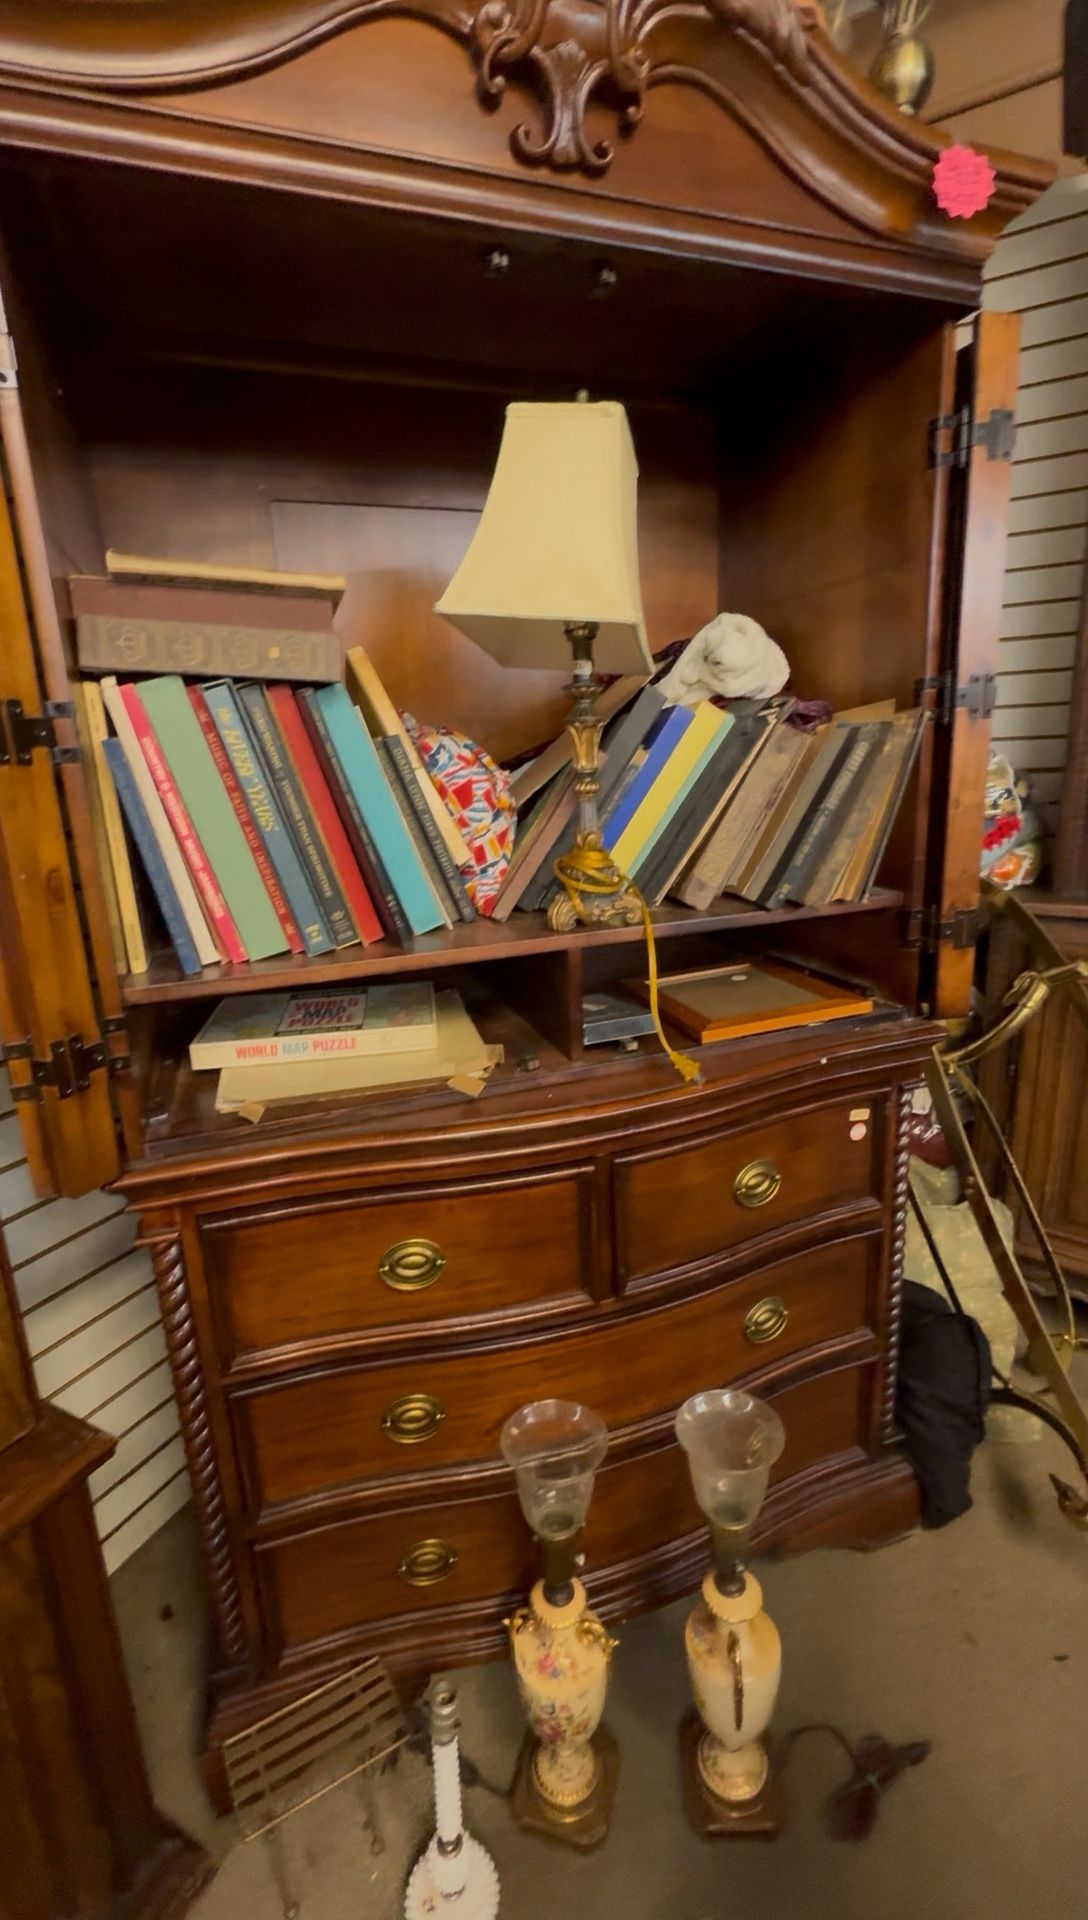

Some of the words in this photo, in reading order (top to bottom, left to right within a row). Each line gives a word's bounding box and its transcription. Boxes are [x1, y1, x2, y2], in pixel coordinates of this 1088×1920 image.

[391, 746, 414, 782] DIANA
[407, 783, 426, 811] LYNN
[141, 734, 168, 783] COUNTRY
[183, 837, 205, 870] MUSIC
[205, 731, 229, 773] MUSIC
[221, 772, 235, 787] OF
[230, 791, 249, 822] FAITH
[243, 824, 259, 847] AND
[253, 850, 288, 915] INSPIRATION
[295, 997, 359, 1011] WORLD
[303, 1007, 347, 1018] MAP
[288, 1014, 352, 1027] PUZZLE
[235, 1043, 278, 1059] WORLD
[282, 1041, 309, 1055] MAP
[312, 1037, 356, 1052] PUZZLE
